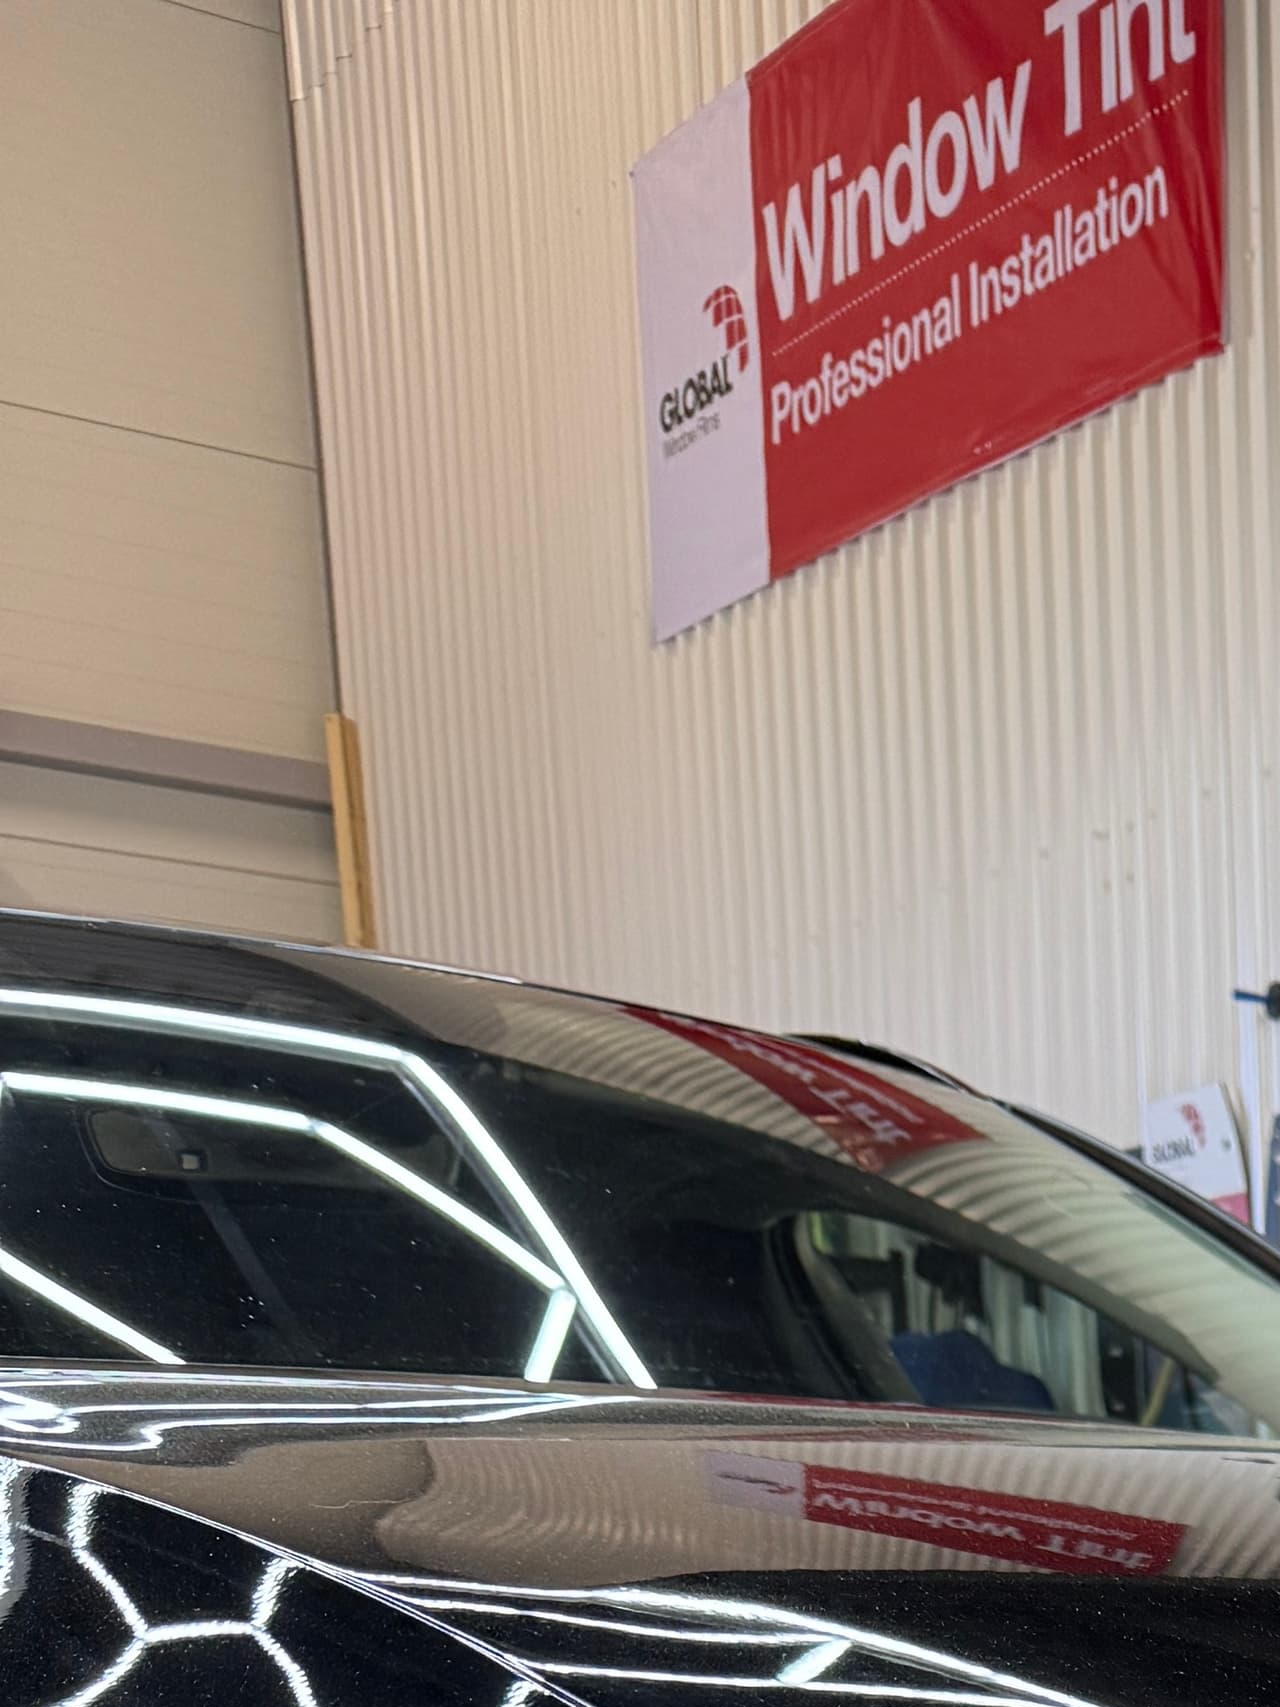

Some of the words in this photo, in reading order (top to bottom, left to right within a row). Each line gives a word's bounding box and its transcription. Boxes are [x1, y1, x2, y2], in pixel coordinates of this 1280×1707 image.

[762, 59, 1032, 322] Window
[771, 273, 961, 446] Professional
[968, 165, 1169, 328] Installation
[660, 353, 733, 433] GLOBAL
